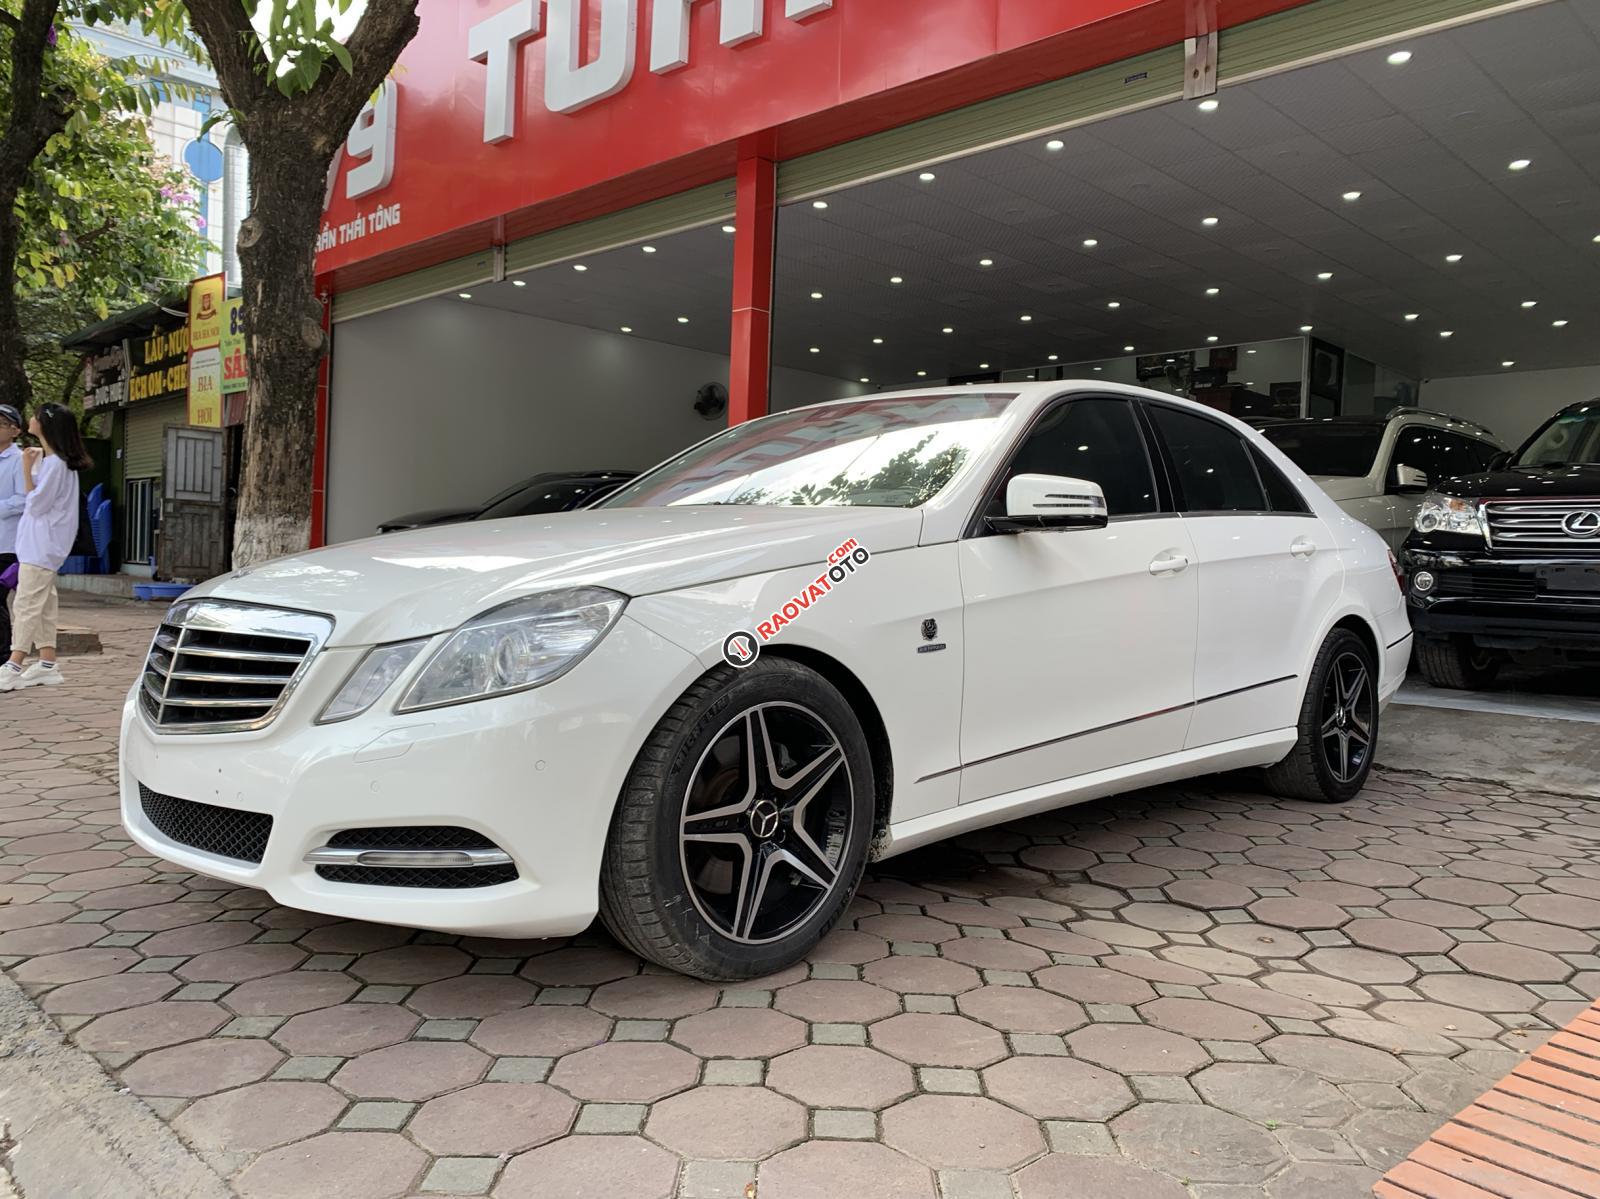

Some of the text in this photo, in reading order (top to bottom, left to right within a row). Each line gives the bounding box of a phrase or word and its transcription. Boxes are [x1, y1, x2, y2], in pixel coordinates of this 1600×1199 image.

[339, 212, 366, 245] THÁI
[368, 203, 401, 234] TÔNG
[197, 375, 213, 393] BIA
